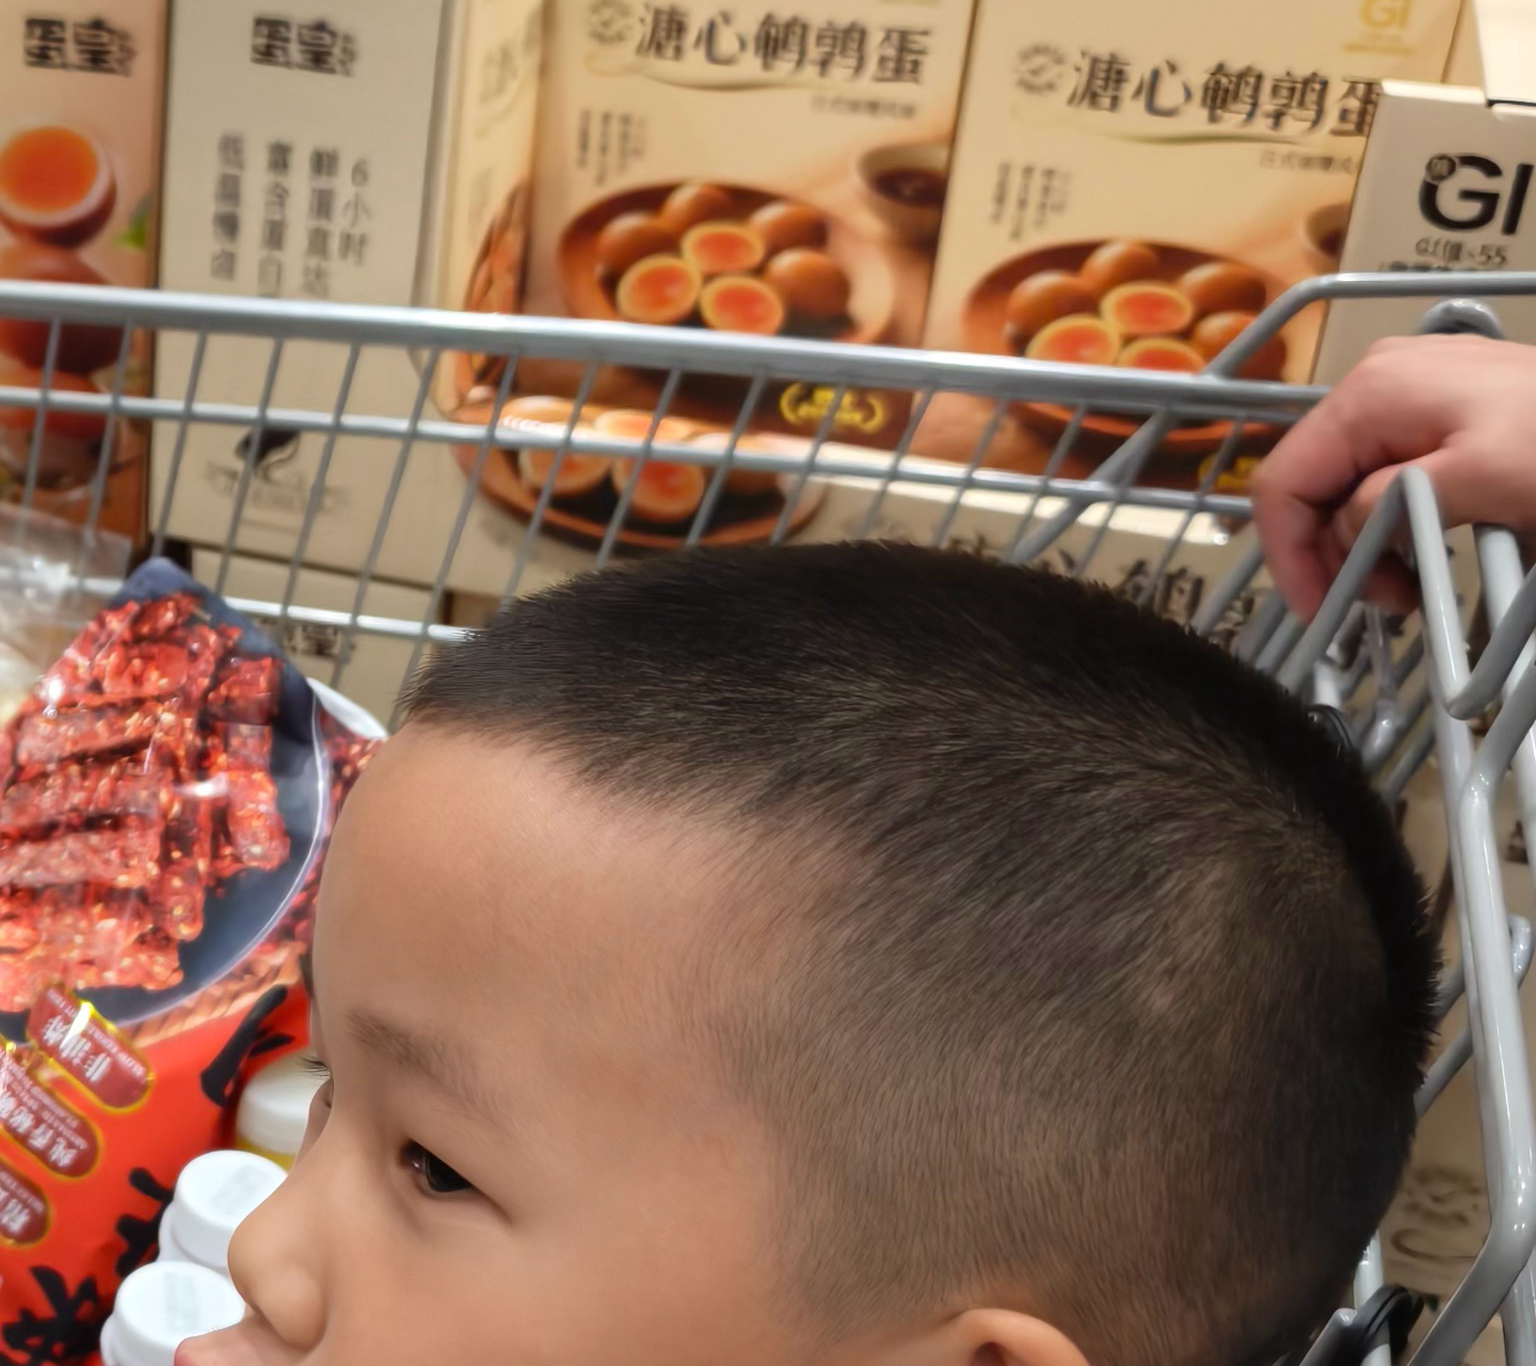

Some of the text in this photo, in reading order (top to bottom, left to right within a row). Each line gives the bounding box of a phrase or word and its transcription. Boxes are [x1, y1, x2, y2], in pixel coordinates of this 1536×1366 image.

[636, 2, 932, 86] 溏心鹌鹑蛋
[1066, 49, 1384, 139] 溏心鹌鹑蛋
[1418, 153, 1535, 236] GI
